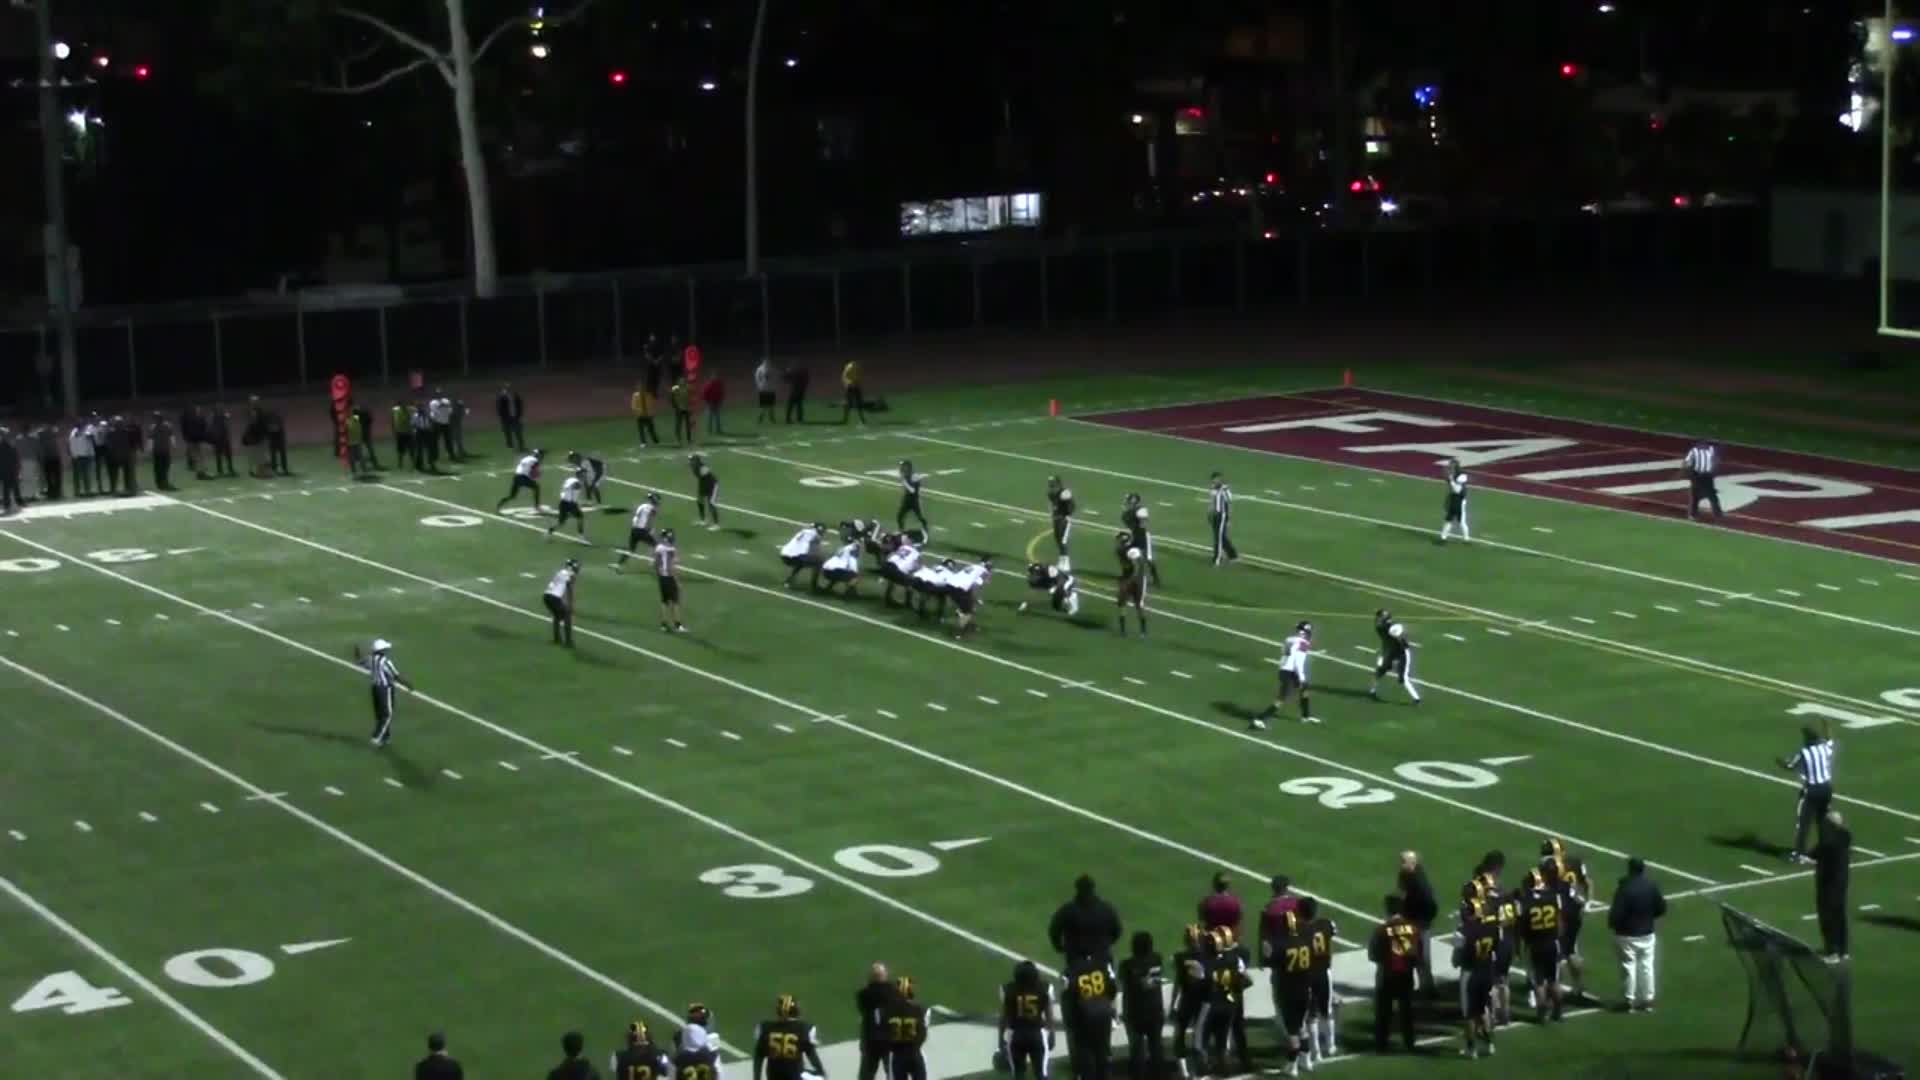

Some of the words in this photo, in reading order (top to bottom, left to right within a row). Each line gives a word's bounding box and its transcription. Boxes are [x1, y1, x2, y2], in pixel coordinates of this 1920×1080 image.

[698, 844, 940, 899] 30
[1529, 904, 1556, 930] 22
[1286, 946, 1311, 972] 78
[11, 948, 275, 1015] 40
[1078, 969, 1106, 999] 68
[1016, 994, 1038, 1018] 15
[767, 1031, 799, 1057] 56
